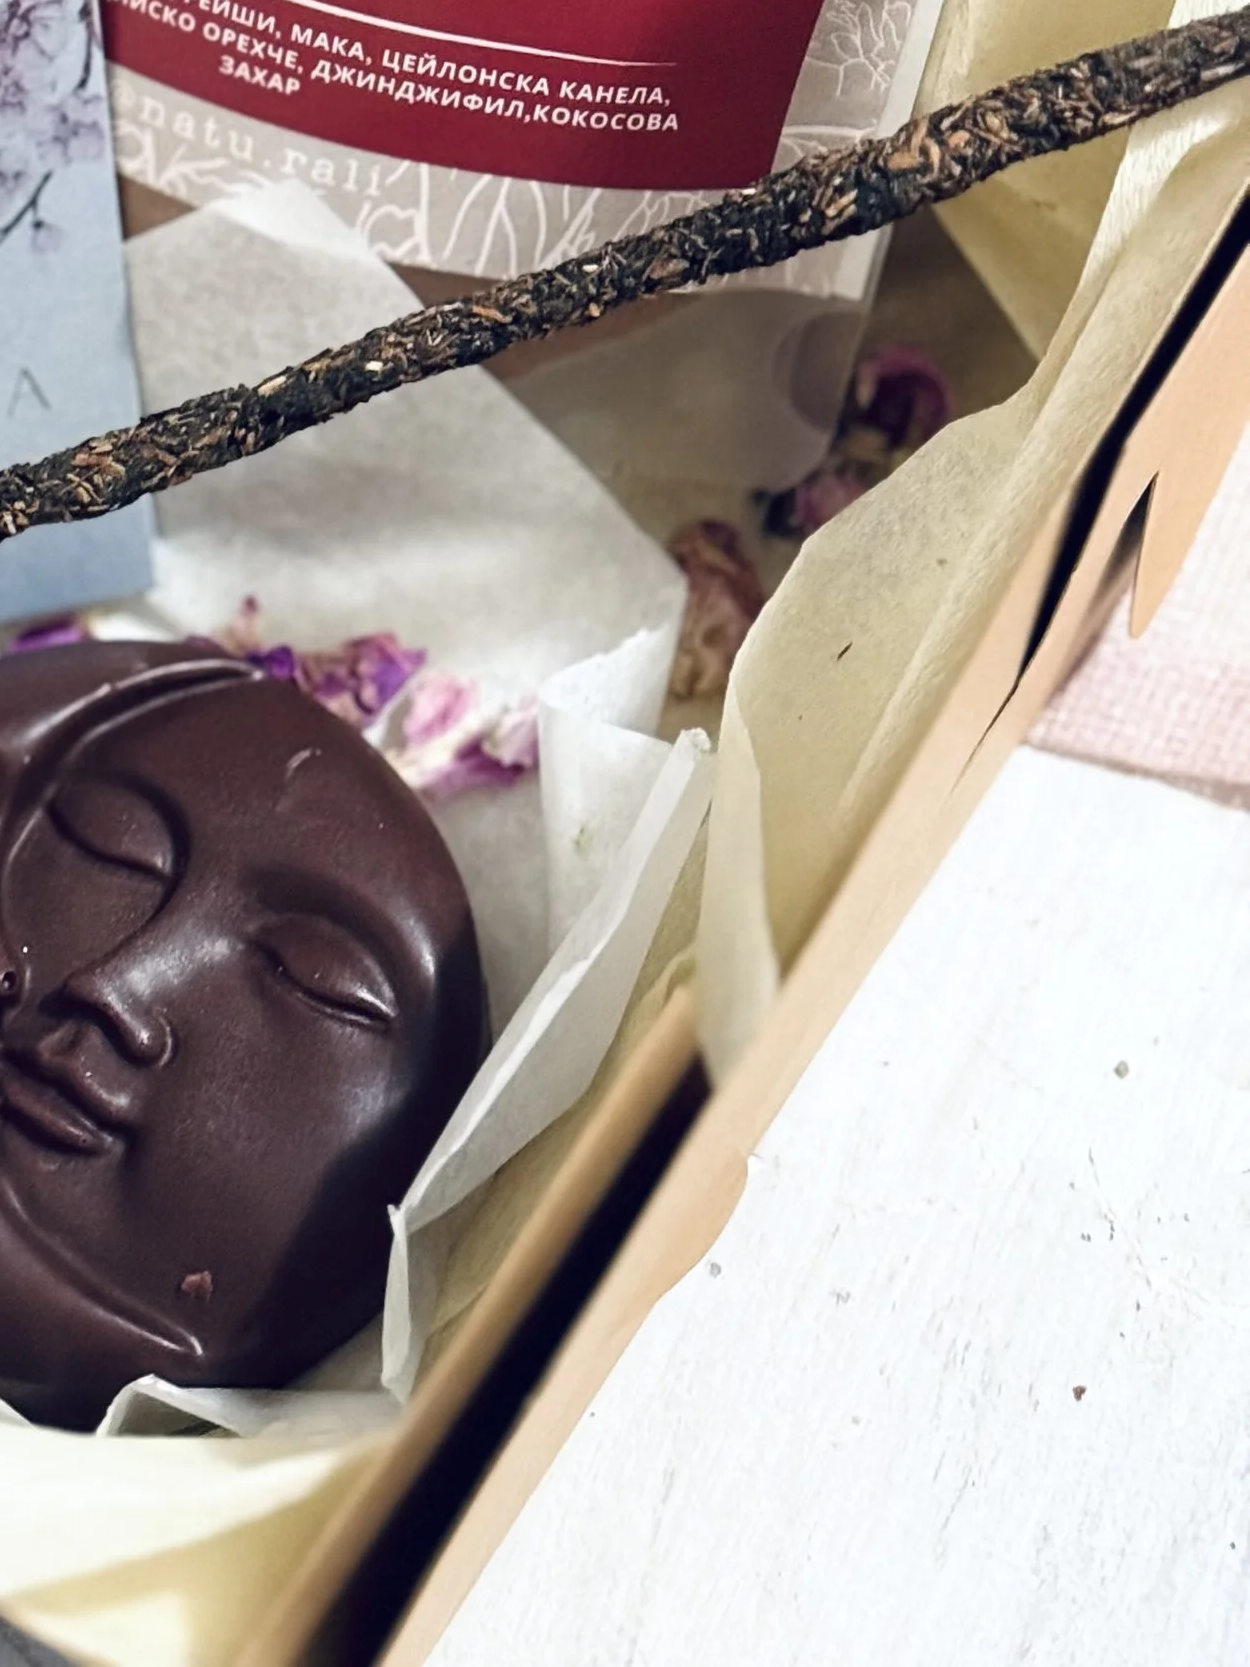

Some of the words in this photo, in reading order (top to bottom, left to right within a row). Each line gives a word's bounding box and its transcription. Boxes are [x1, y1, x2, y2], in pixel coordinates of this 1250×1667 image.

[202, 21, 304, 74] ОРЕХЧЕ,
[290, 23, 373, 66] МАКА,
[381, 49, 550, 96] ЦЕЙЛОНСКА
[559, 81, 671, 107] КАНЕЛА,
[218, 55, 301, 96] ЗАХАР
